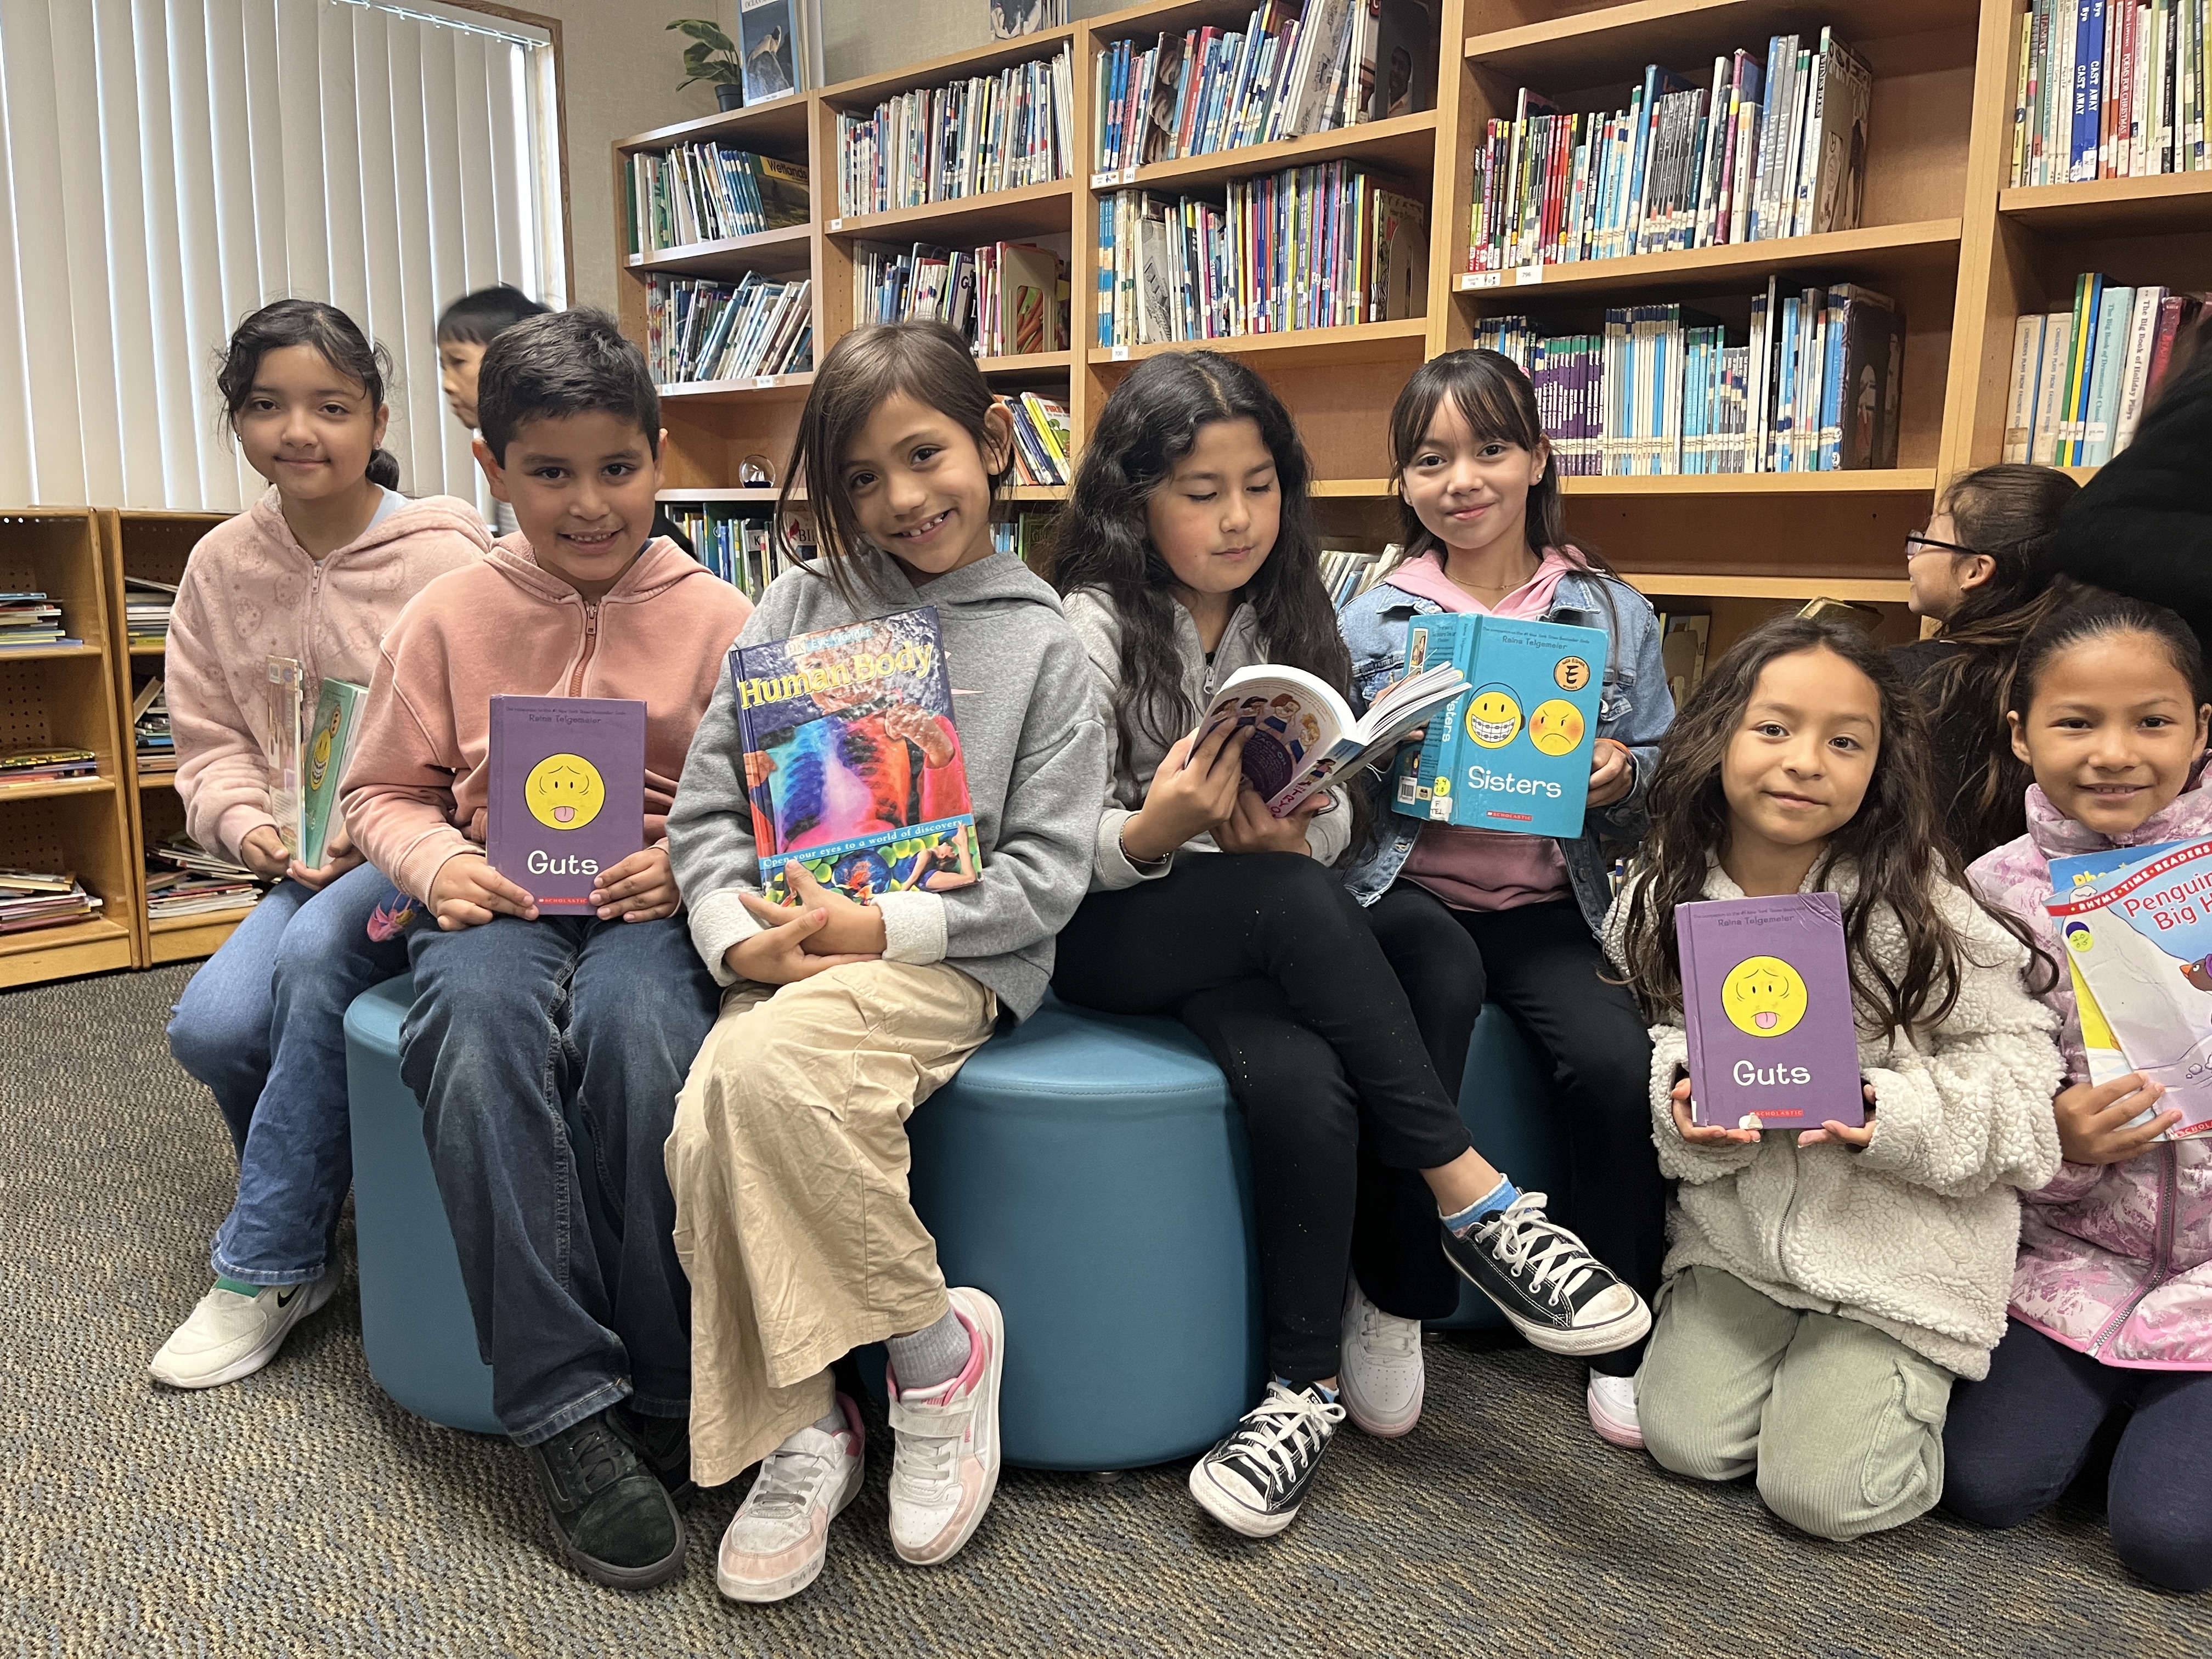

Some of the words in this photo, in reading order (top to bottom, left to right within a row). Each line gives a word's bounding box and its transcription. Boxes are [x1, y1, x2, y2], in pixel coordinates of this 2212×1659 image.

[2090, 60, 2099, 84] CAST
[2122, 53, 2131, 77] POEMS
[2077, 65, 2086, 88] CAST
[2121, 78, 2130, 92] FOR
[2075, 93, 2085, 115] AWAY
[2089, 89, 2098, 111] AWAY
[2120, 93, 2129, 134] CHRISTMAS
[1765, 114, 1780, 172] baseball
[1775, 112, 1790, 170] baseball
[766, 159, 808, 180] Wetlands
[2107, 304, 2115, 317] The
[2142, 300, 2151, 316] The
[2104, 318, 2113, 330] Big
[2138, 318, 2148, 331] Big
[2102, 332, 2111, 349] Book
[2136, 333, 2146, 353] Book
[2135, 356, 2143, 365] of
[2129, 366, 2142, 396] Holiday
[2125, 399, 2136, 420] Plays
[799, 529, 815, 541] BI
[810, 636, 830, 651] Eye
[832, 628, 872, 647] Wonder
[1502, 635, 1523, 645] Raina
[1526, 638, 1568, 650] Telgemeier
[738, 661, 851, 709] Human
[851, 640, 934, 683] Body
[1468, 765, 1562, 798] Sisters
[1271, 788, 1304, 817] TRYO
[1492, 812, 1532, 821] SCHOLASTIC
[763, 856, 791, 868] Open
[793, 849, 817, 863] your
[820, 843, 842, 857] eyes
[845, 842, 856, 851] to
[868, 830, 898, 845] world
[900, 828, 911, 839] of
[915, 818, 963, 837] discovery
[527, 850, 599, 875] Guts
[2078, 890, 2119, 911] RHYME
[2121, 870, 2151, 891] TIME
[2154, 845, 2210, 872] READERS
[1718, 918, 1741, 927] Raina
[1745, 915, 1795, 926] Telgemeier
[2153, 906, 2198, 930] Big
[1733, 1060, 1811, 1086] Guts
[2178, 1121, 2212, 1136] SCHOL
